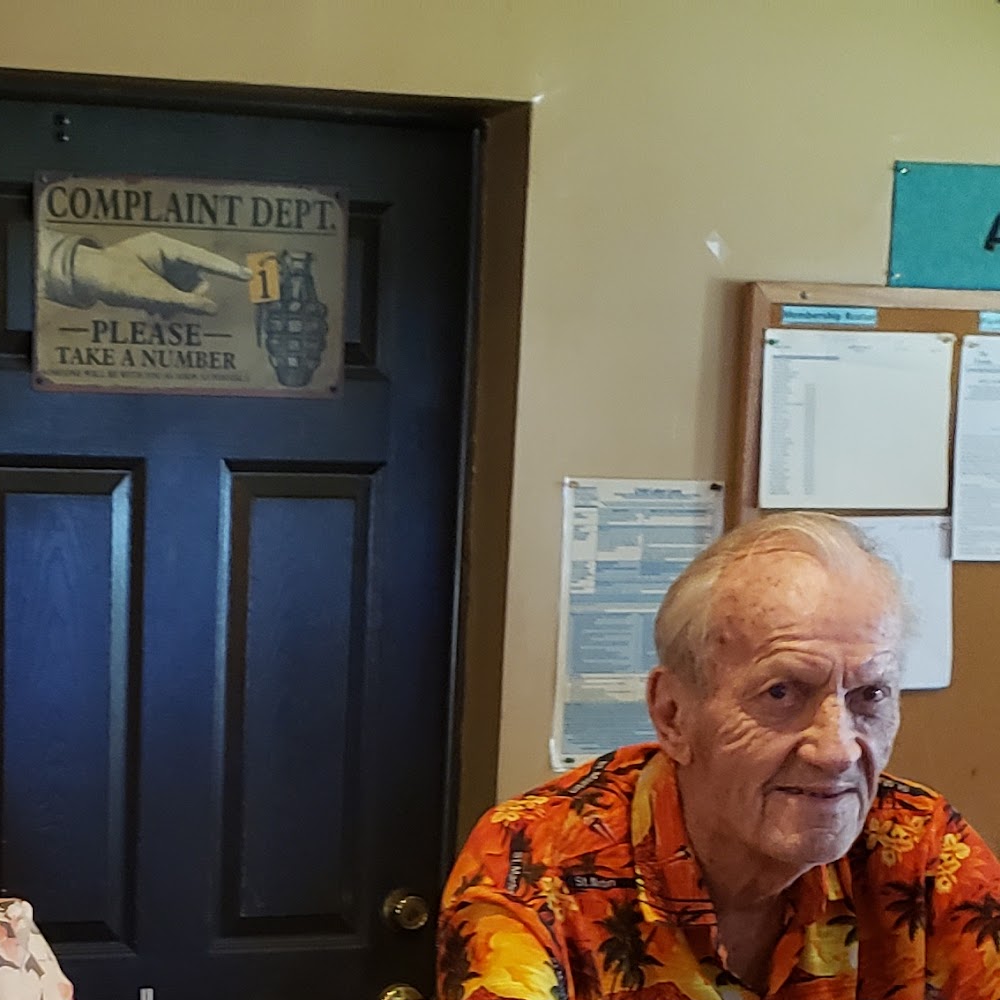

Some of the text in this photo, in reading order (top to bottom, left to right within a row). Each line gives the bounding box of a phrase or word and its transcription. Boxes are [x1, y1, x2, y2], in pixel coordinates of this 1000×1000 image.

[47, 186, 337, 231] COMPLAINT DEPT.
[91, 320, 203, 346] PLEASE
[56, 346, 237, 370] TAKE A NUMBER
